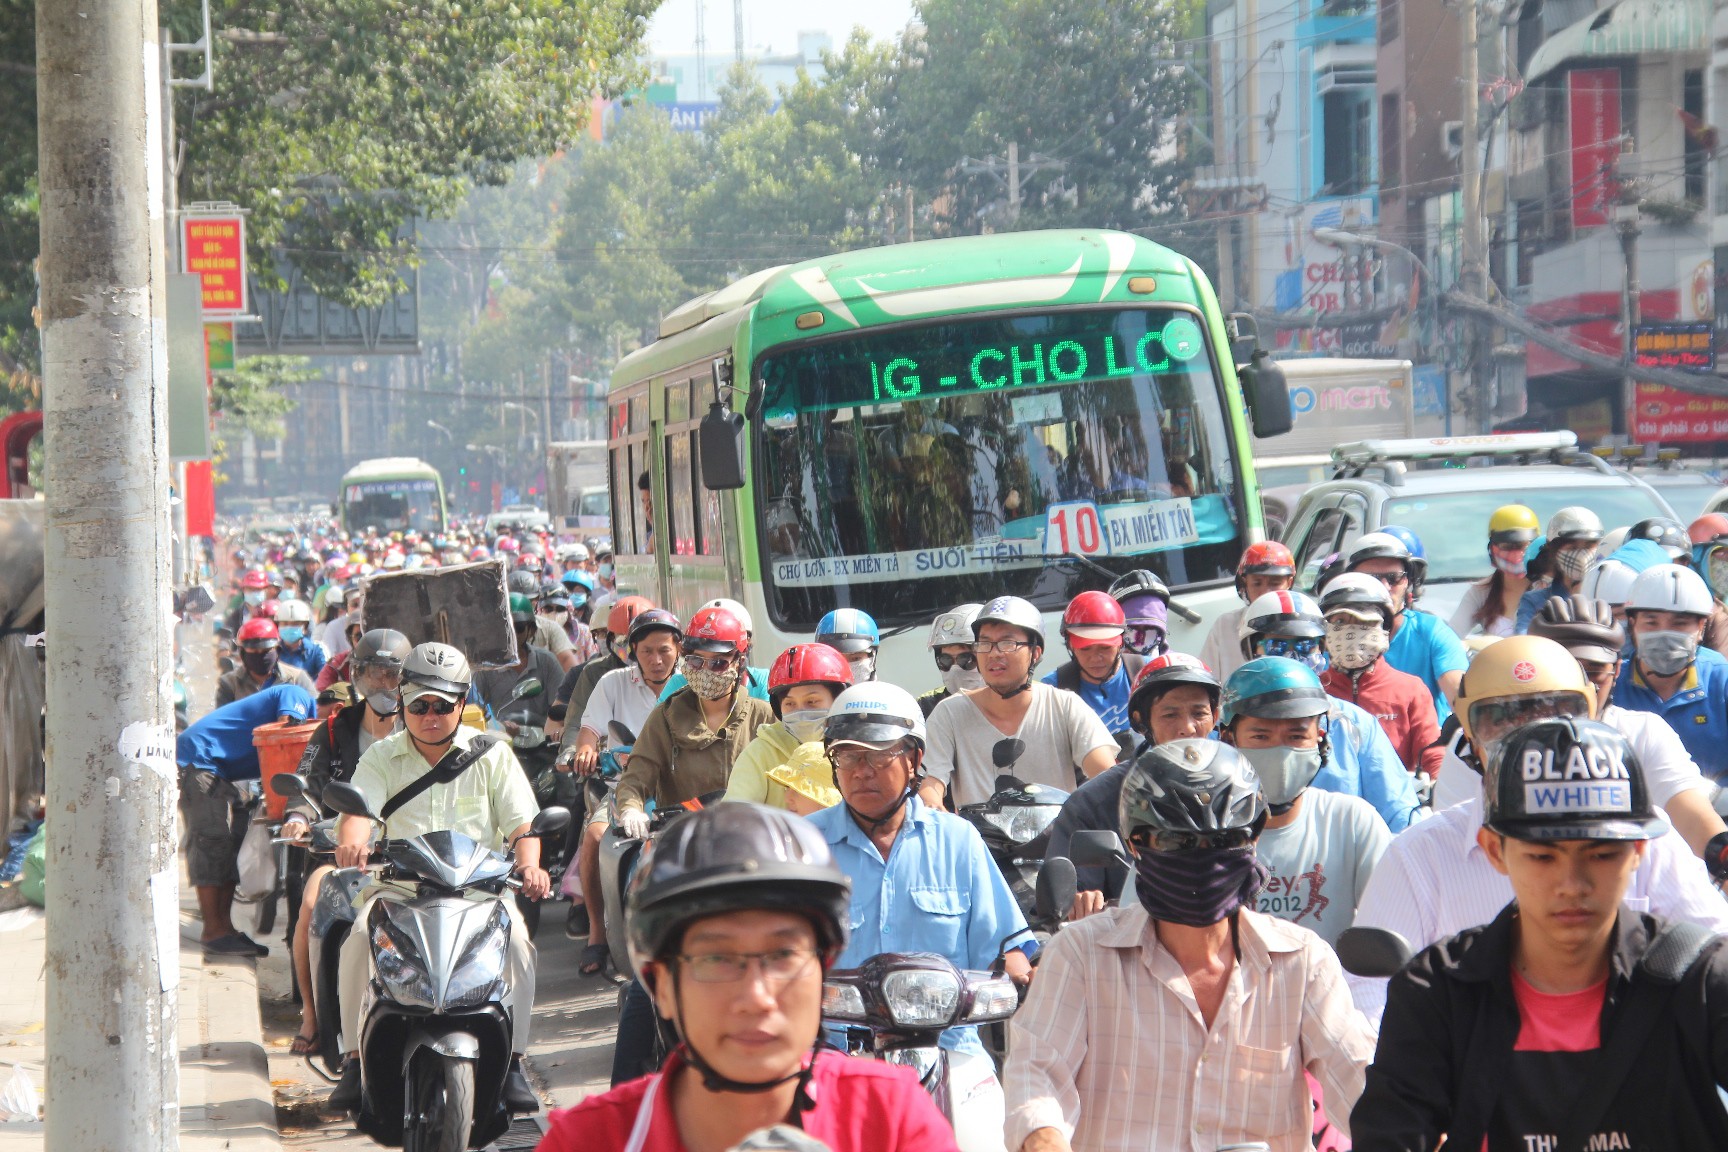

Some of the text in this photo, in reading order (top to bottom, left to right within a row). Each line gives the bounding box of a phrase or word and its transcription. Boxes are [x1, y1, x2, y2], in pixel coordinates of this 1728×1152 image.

[971, 340, 1088, 389] CHO
[1320, 385, 1392, 411] mart
[1050, 506, 1100, 554] 10
[1111, 518, 1131, 547] BX
[1169, 503, 1194, 538] TÂY
[778, 561, 801, 582] CHỢ
[834, 560, 849, 576] BX
[845, 701, 888, 710] PHILIPS
[1522, 745, 1630, 781] BLACK
[1534, 786, 1625, 808] WHITE
[1267, 875, 1297, 896] ey
[1260, 896, 1302, 913] 2012
